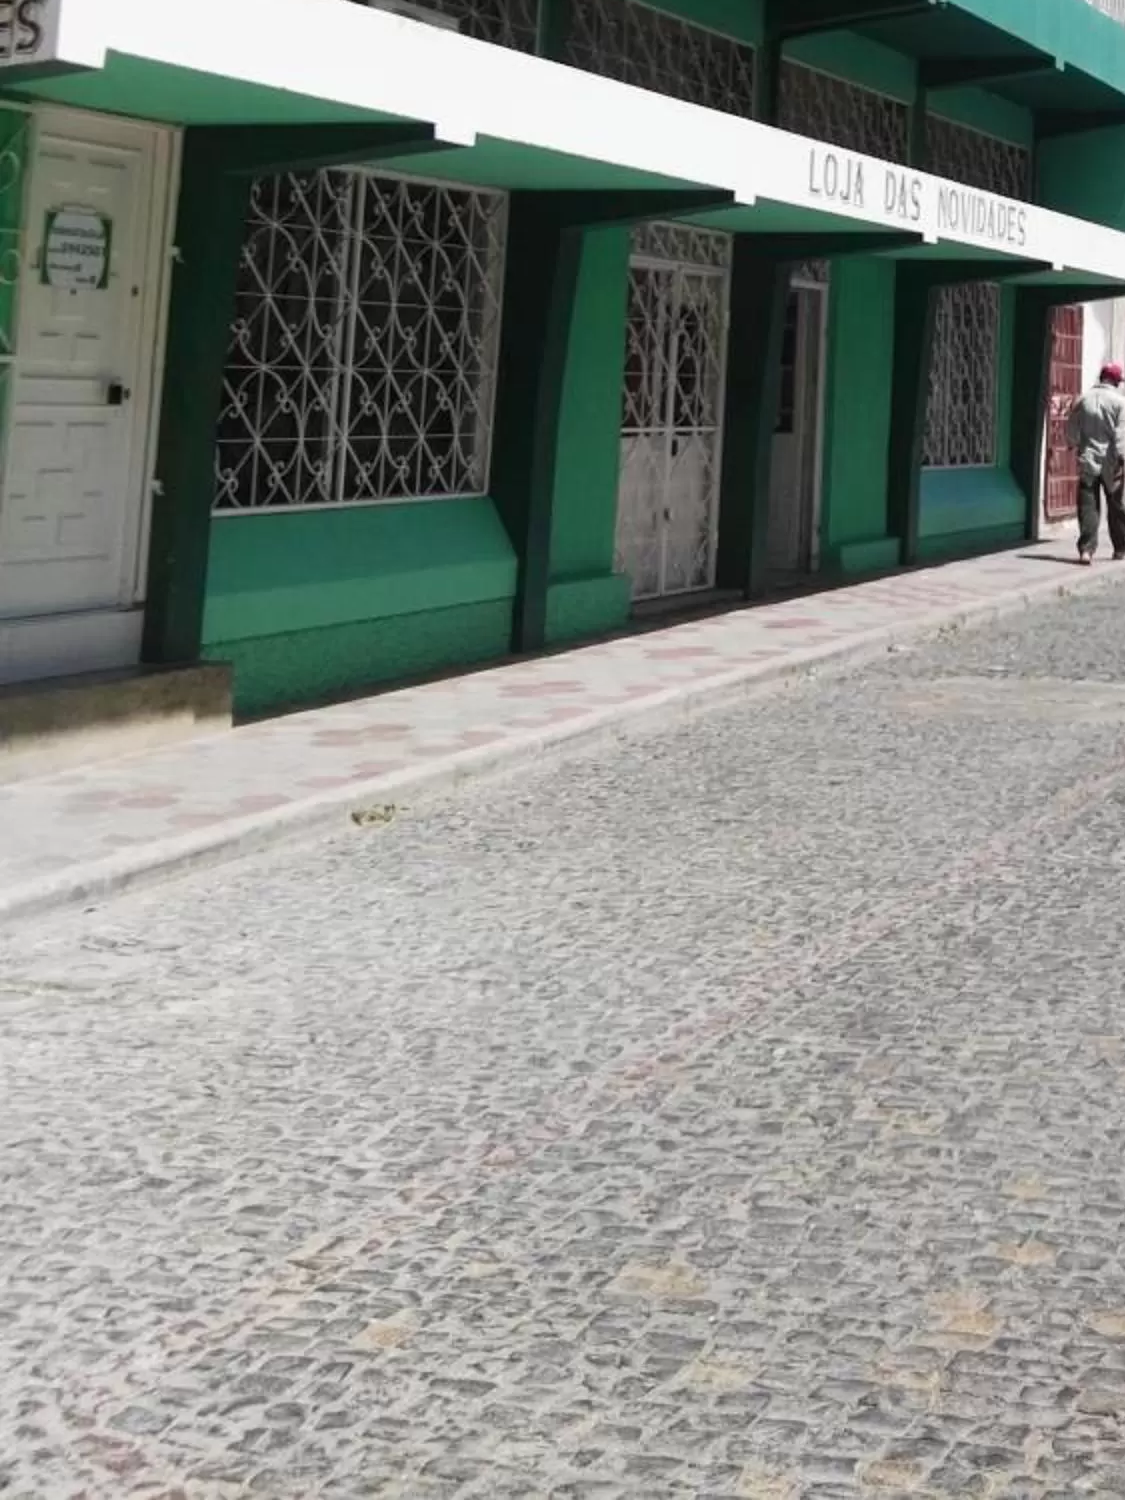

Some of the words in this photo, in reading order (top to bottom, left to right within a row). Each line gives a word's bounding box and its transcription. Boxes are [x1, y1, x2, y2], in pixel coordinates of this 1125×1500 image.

[808, 148, 864, 208] LOJA
[884, 169, 922, 221] DAS
[937, 185, 1026, 246] NOVIDADES
